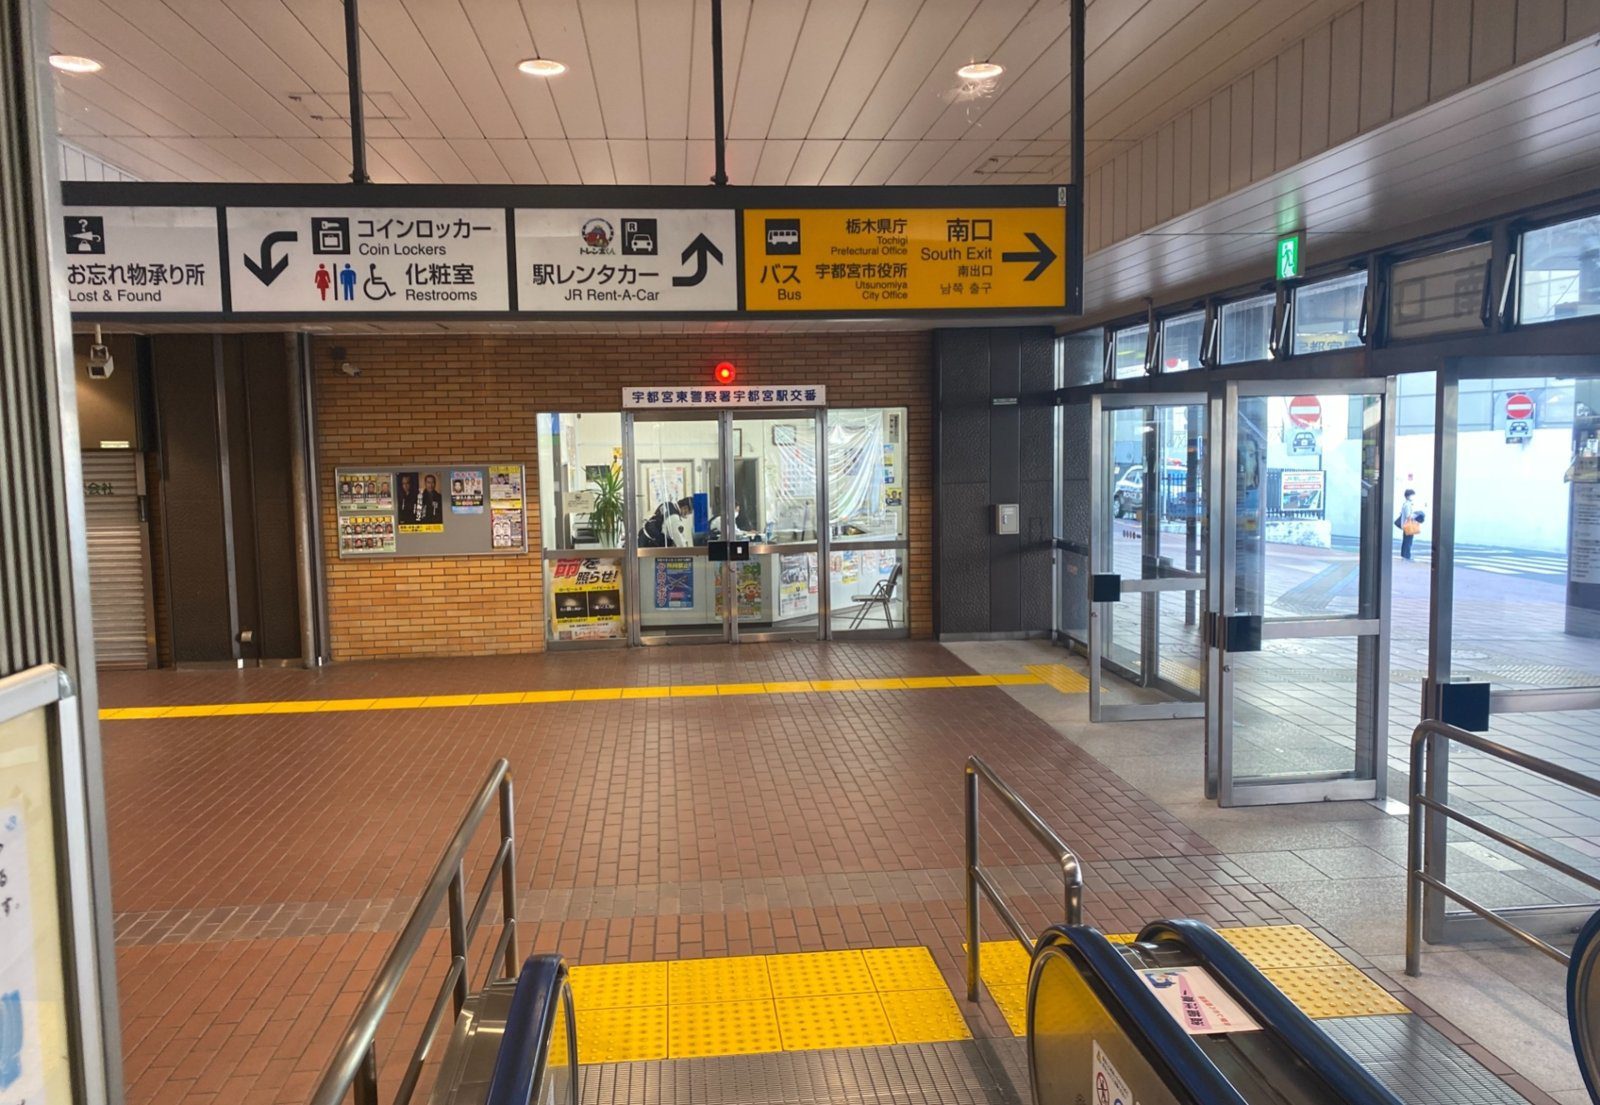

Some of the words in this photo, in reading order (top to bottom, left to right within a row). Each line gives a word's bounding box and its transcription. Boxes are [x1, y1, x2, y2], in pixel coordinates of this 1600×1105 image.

[357, 217, 492, 240] コインロッカー
[846, 218, 909, 235] 栃木県庁
[946, 217, 993, 242] 南口
[876, 235, 908, 246] Tochigi
[358, 243, 390, 256] Coin
[394, 243, 447, 256] Lockers
[830, 246, 880, 256] Prefectural
[881, 246, 908, 256] Office
[920, 246, 962, 262] South
[966, 246, 993, 261] Exit
[67, 262, 205, 286] お忘れ物承り所
[405, 262, 475, 286] 化粧室
[532, 263, 660, 286] 駅レンタカー
[759, 263, 801, 284] バス
[815, 262, 908, 280] 宇都宮市役所
[957, 264, 993, 278] 南出口
[854, 280, 908, 291] Utsunomiya
[68, 289, 98, 302] Lost
[102, 289, 113, 302] &
[117, 289, 163, 302] Found
[405, 288, 478, 301] Restrooms
[564, 288, 583, 301] JR
[586, 288, 660, 301] Rent-A-Car
[777, 288, 802, 301] Bus
[861, 290, 879, 302] City
[881, 290, 908, 301] Office
[631, 388, 818, 405] 宇都宮東警察署宇都宮駅交番
[575, 570, 619, 585] 照らせ!
